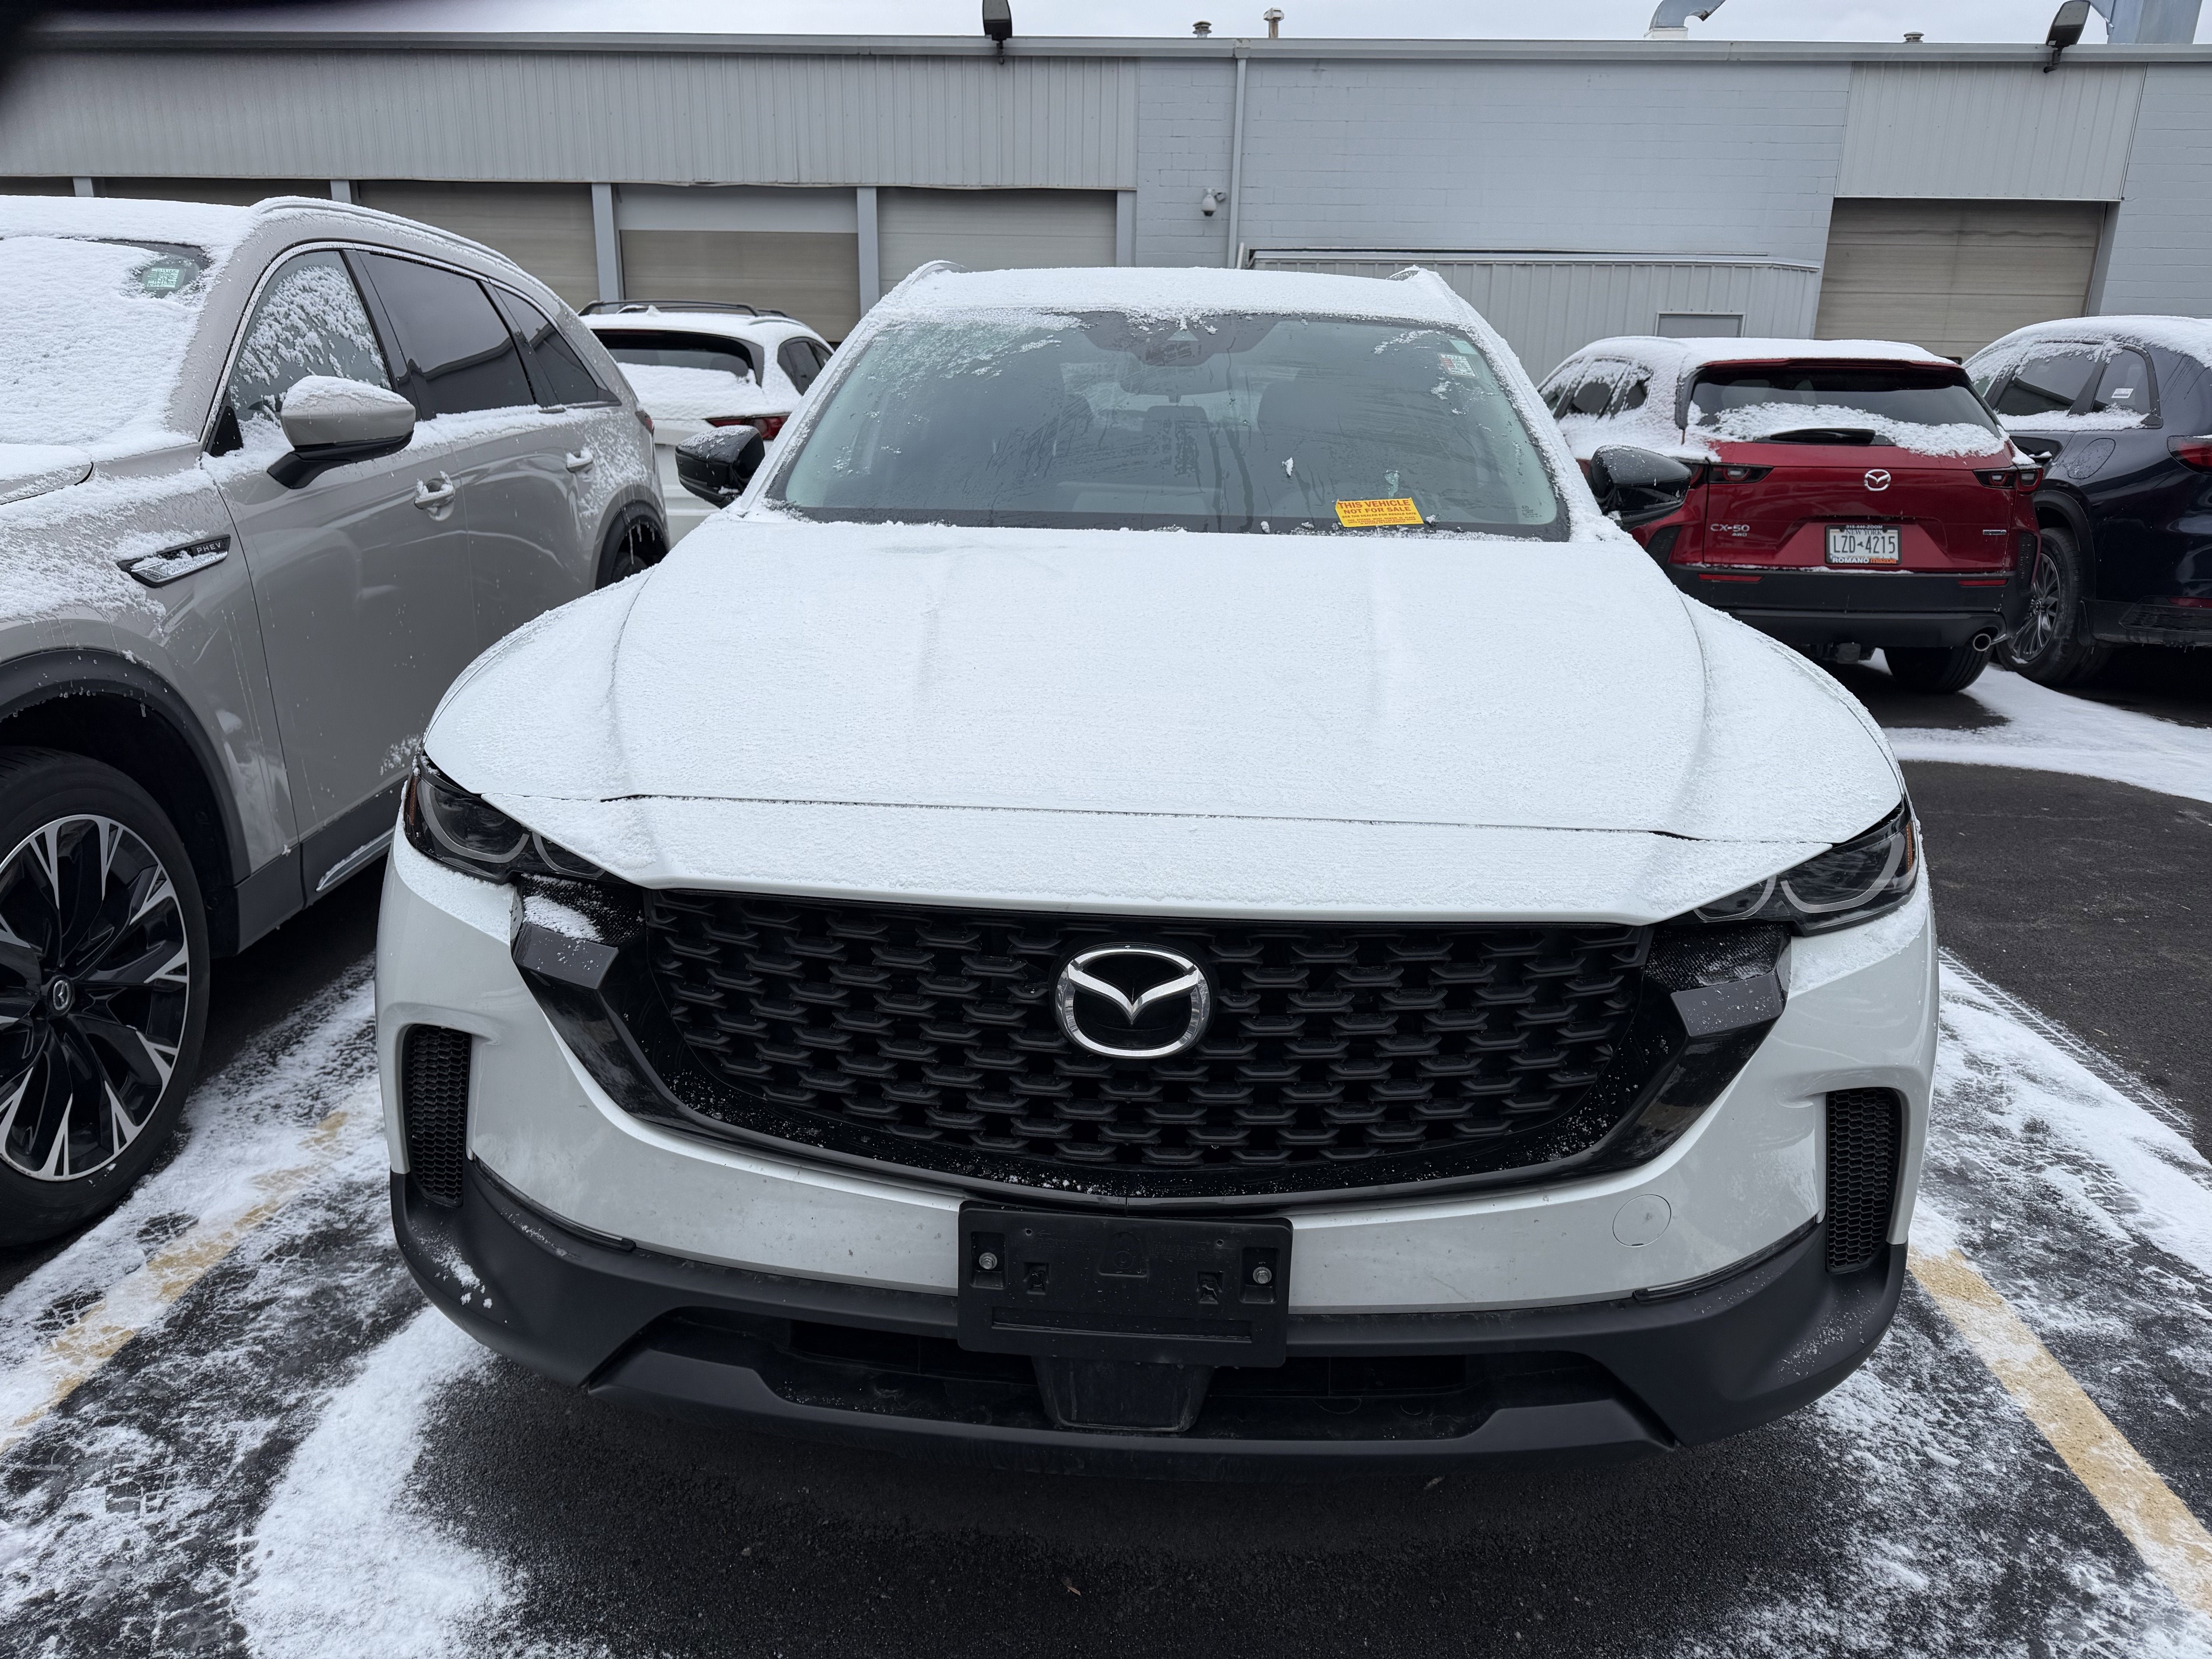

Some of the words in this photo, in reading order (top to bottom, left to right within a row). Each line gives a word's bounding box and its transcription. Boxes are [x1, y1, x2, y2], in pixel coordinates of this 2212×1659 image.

[1710, 523, 1750, 532] CX-50
[196, 542, 221, 553] PHEV
[1834, 535, 1856, 553] LZD
[1865, 536, 1895, 554] 4215
